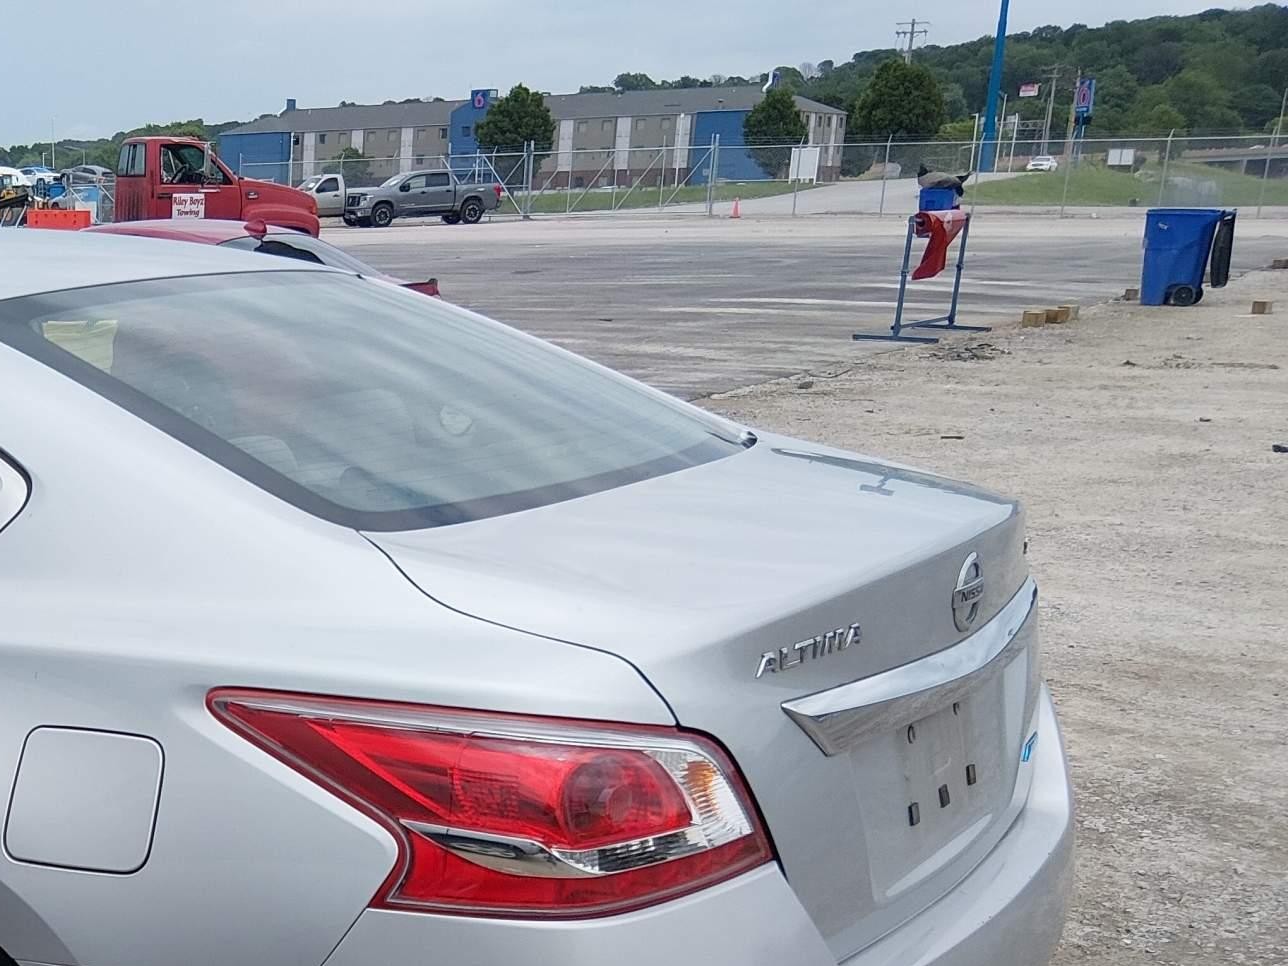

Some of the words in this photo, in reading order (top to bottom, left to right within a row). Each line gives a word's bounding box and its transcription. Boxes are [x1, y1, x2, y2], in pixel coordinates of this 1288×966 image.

[474, 92, 485, 108] 6
[173, 196, 189, 208] Riley
[176, 208, 200, 218] Towing
[755, 622, 862, 680] ALTIMA
